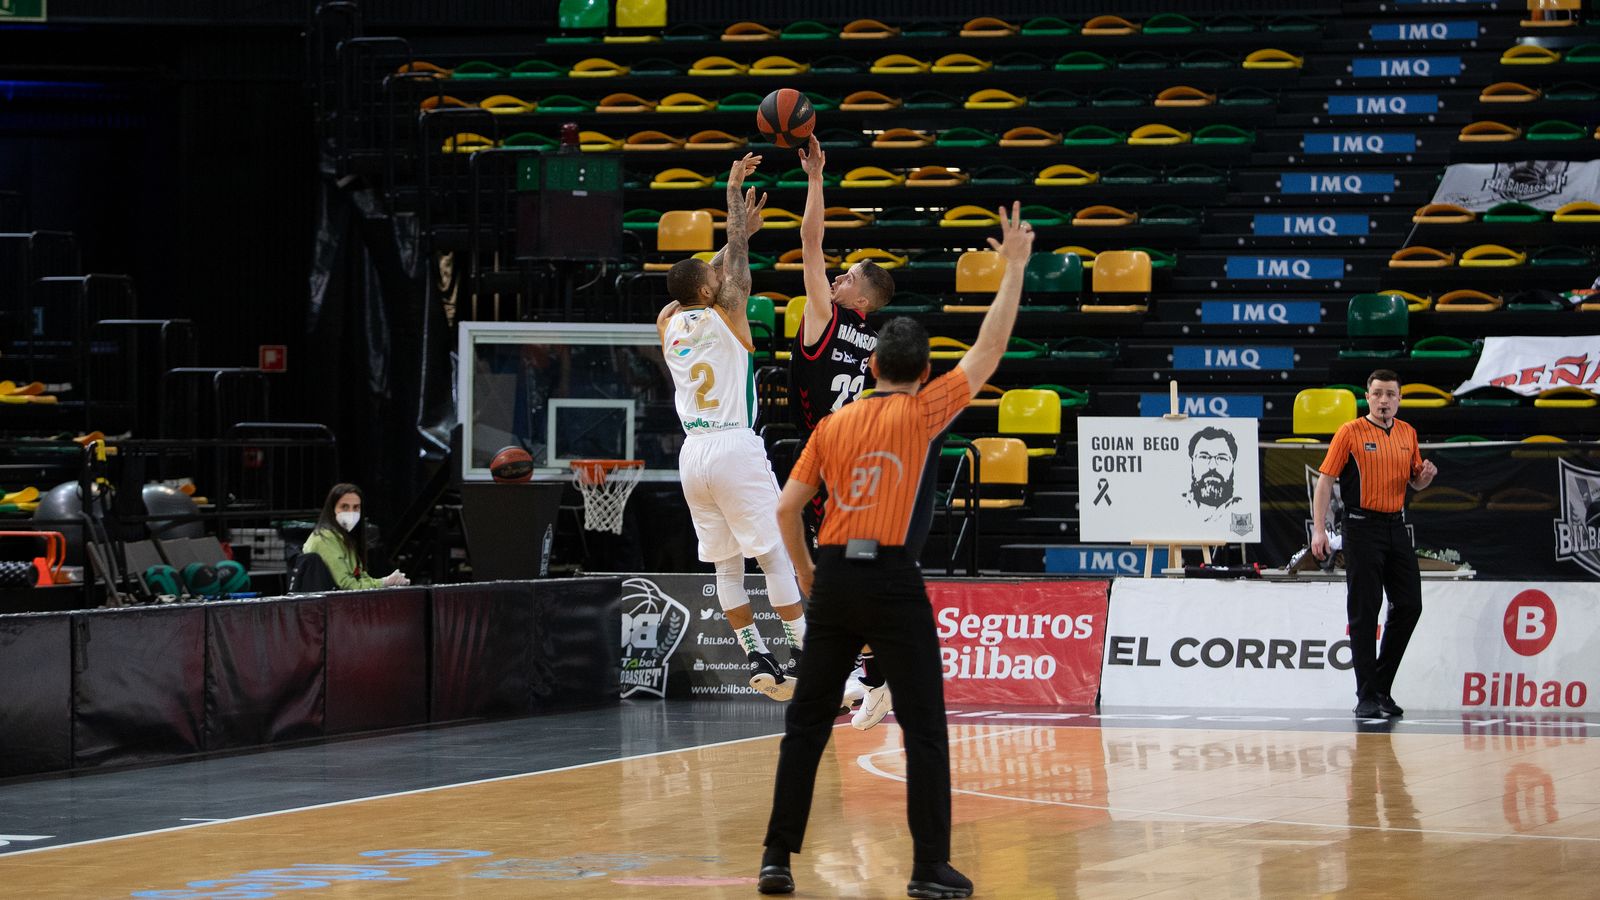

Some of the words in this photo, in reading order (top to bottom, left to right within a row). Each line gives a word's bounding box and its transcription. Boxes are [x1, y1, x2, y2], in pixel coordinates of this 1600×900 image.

[1400, 24, 1447, 40] IMQ
[1381, 60, 1430, 76] IMQ
[1356, 96, 1407, 114] IMQ
[1332, 136, 1384, 153] IMQ
[1310, 175, 1362, 193] IMQ
[1283, 216, 1337, 236] IMQ
[1257, 260, 1311, 279] IMQ
[1232, 304, 1288, 324] IMQ
[1204, 348, 1262, 370] IMQ
[689, 362, 721, 412] 2
[1182, 396, 1231, 418] MQ
[1091, 436, 1134, 451] GOIAN
[1143, 436, 1180, 451] BEGO
[1092, 455, 1142, 473] CORTI
[1079, 551, 1140, 573] IMQ
[937, 607, 1093, 645] Seguros
[1515, 606, 1547, 640] B
[703, 637, 736, 646] BILBAO
[1107, 635, 1161, 666] EL
[1170, 637, 1355, 670] CORREO
[940, 646, 1057, 680] Bilbao
[691, 683, 764, 695] www.bilbaob
[1463, 672, 1587, 708] Bilbao
